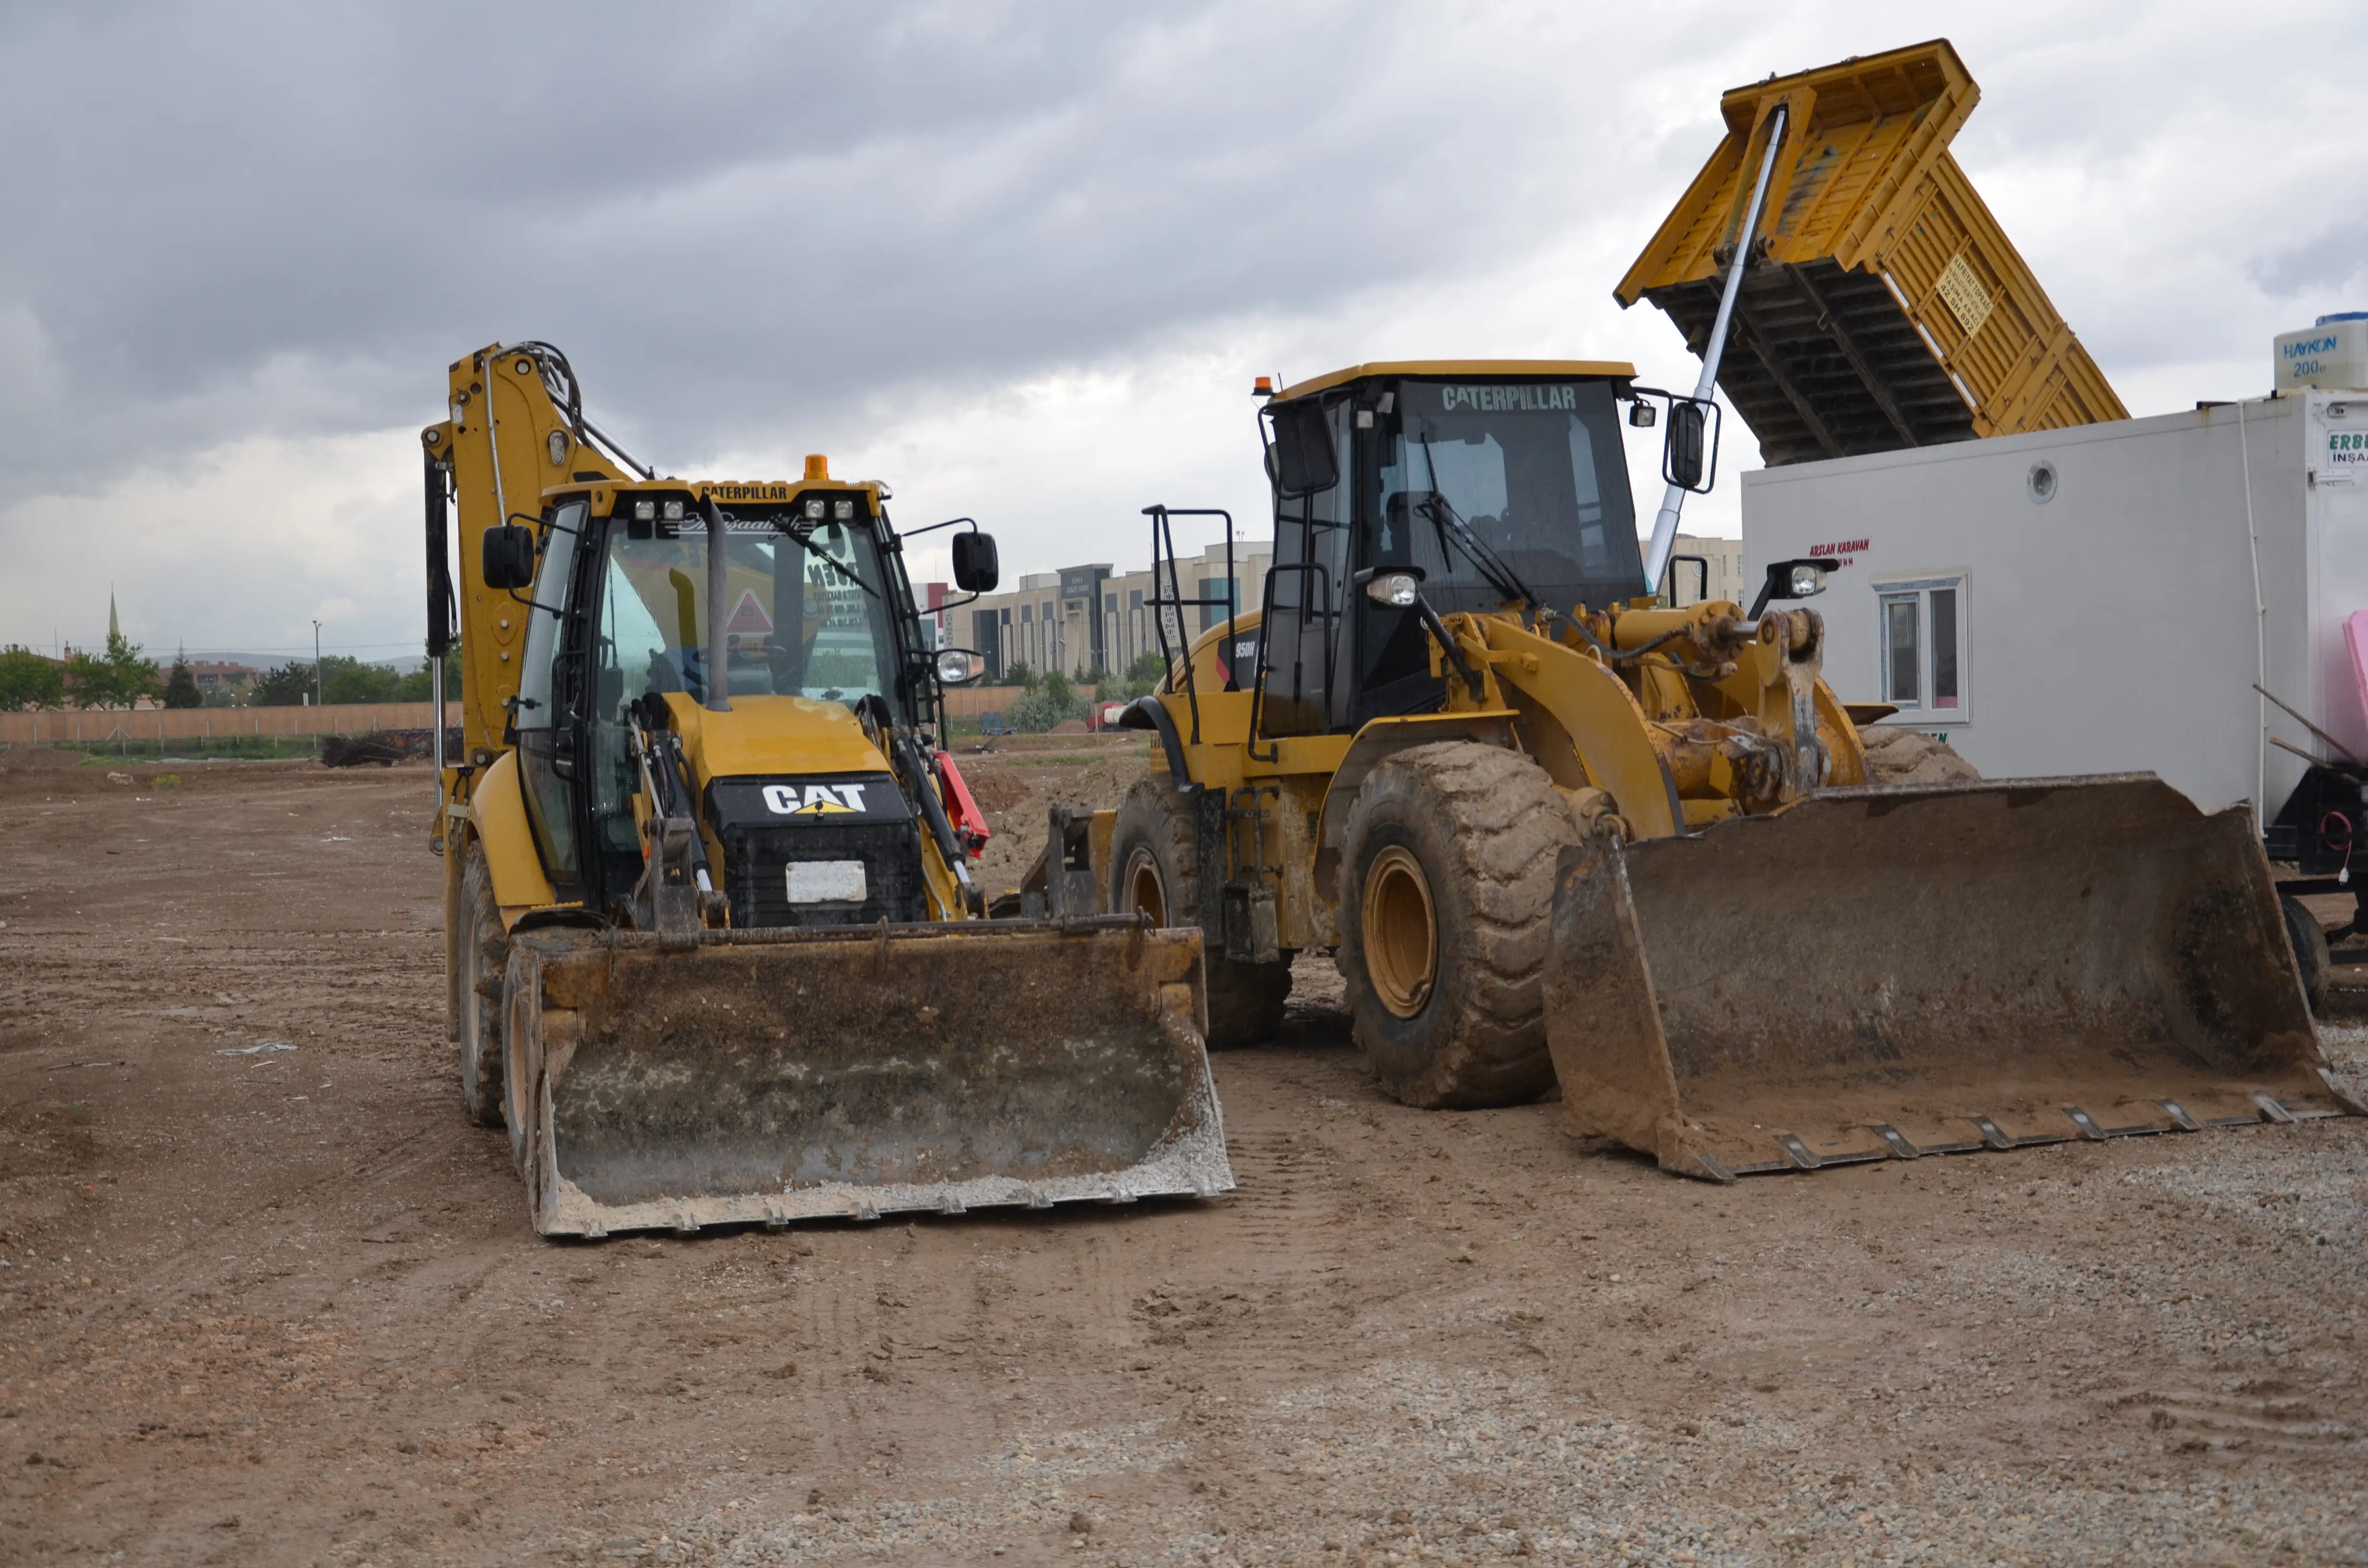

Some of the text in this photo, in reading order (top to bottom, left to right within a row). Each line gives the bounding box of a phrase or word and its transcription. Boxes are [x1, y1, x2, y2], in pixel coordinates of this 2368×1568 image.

[1953, 257, 1975, 287] HAFRİYAT
[1941, 285, 1973, 332] 42 SH 892
[1945, 274, 1979, 327] TAŞIMA ARACI
[2284, 336, 2337, 359] HAYKON
[2294, 360, 2319, 378] 200
[1442, 386, 1577, 411] CATERPILLAR
[2333, 451, 2368, 464] İNŞA
[702, 486, 787, 500] CATERPILLAR
[1810, 539, 1869, 557] ARSLAN KARAVAN
[740, 605, 753, 617] 25
[1235, 641, 1255, 658] 950H
[762, 784, 866, 814] CAT
